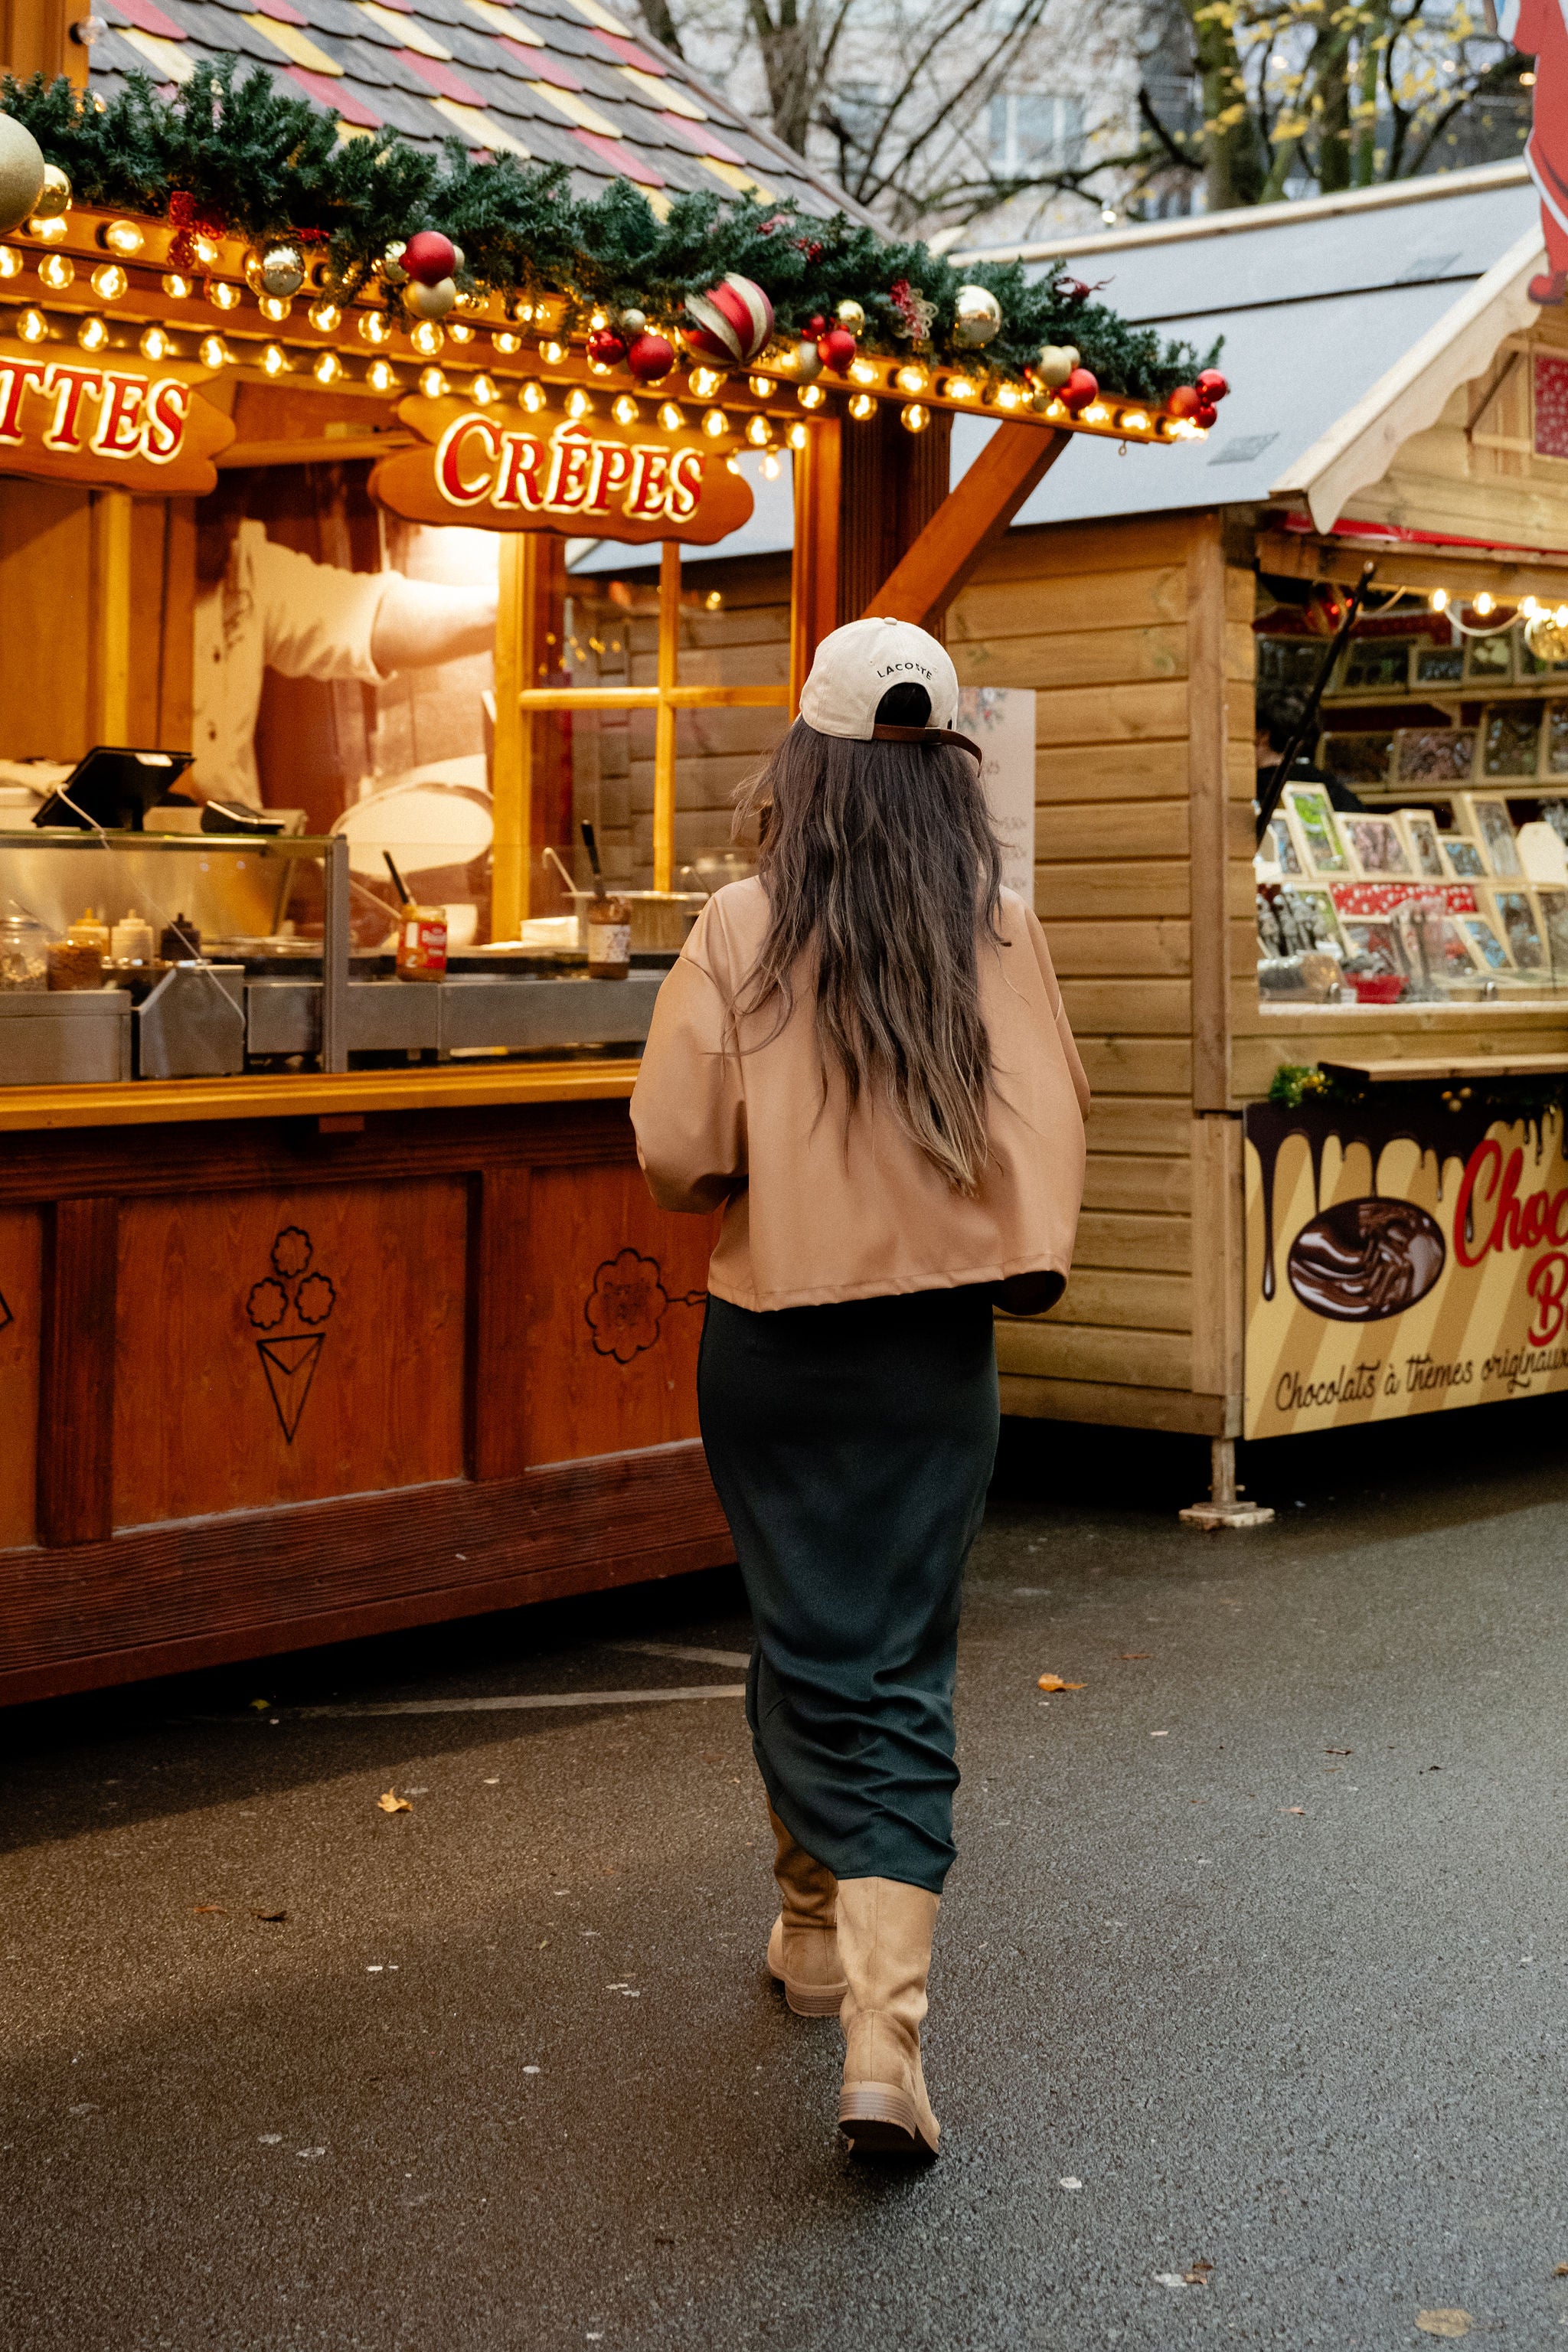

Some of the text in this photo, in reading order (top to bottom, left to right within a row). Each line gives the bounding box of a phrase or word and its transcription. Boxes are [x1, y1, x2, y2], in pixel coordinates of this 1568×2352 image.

[435, 412, 704, 523] CRÊPES
[877, 662, 933, 680] LACOSTE
[1527, 1250, 1568, 1348] B
[1276, 1360, 1381, 1411] Chocolats
[1383, 1364, 1400, 1396] à
